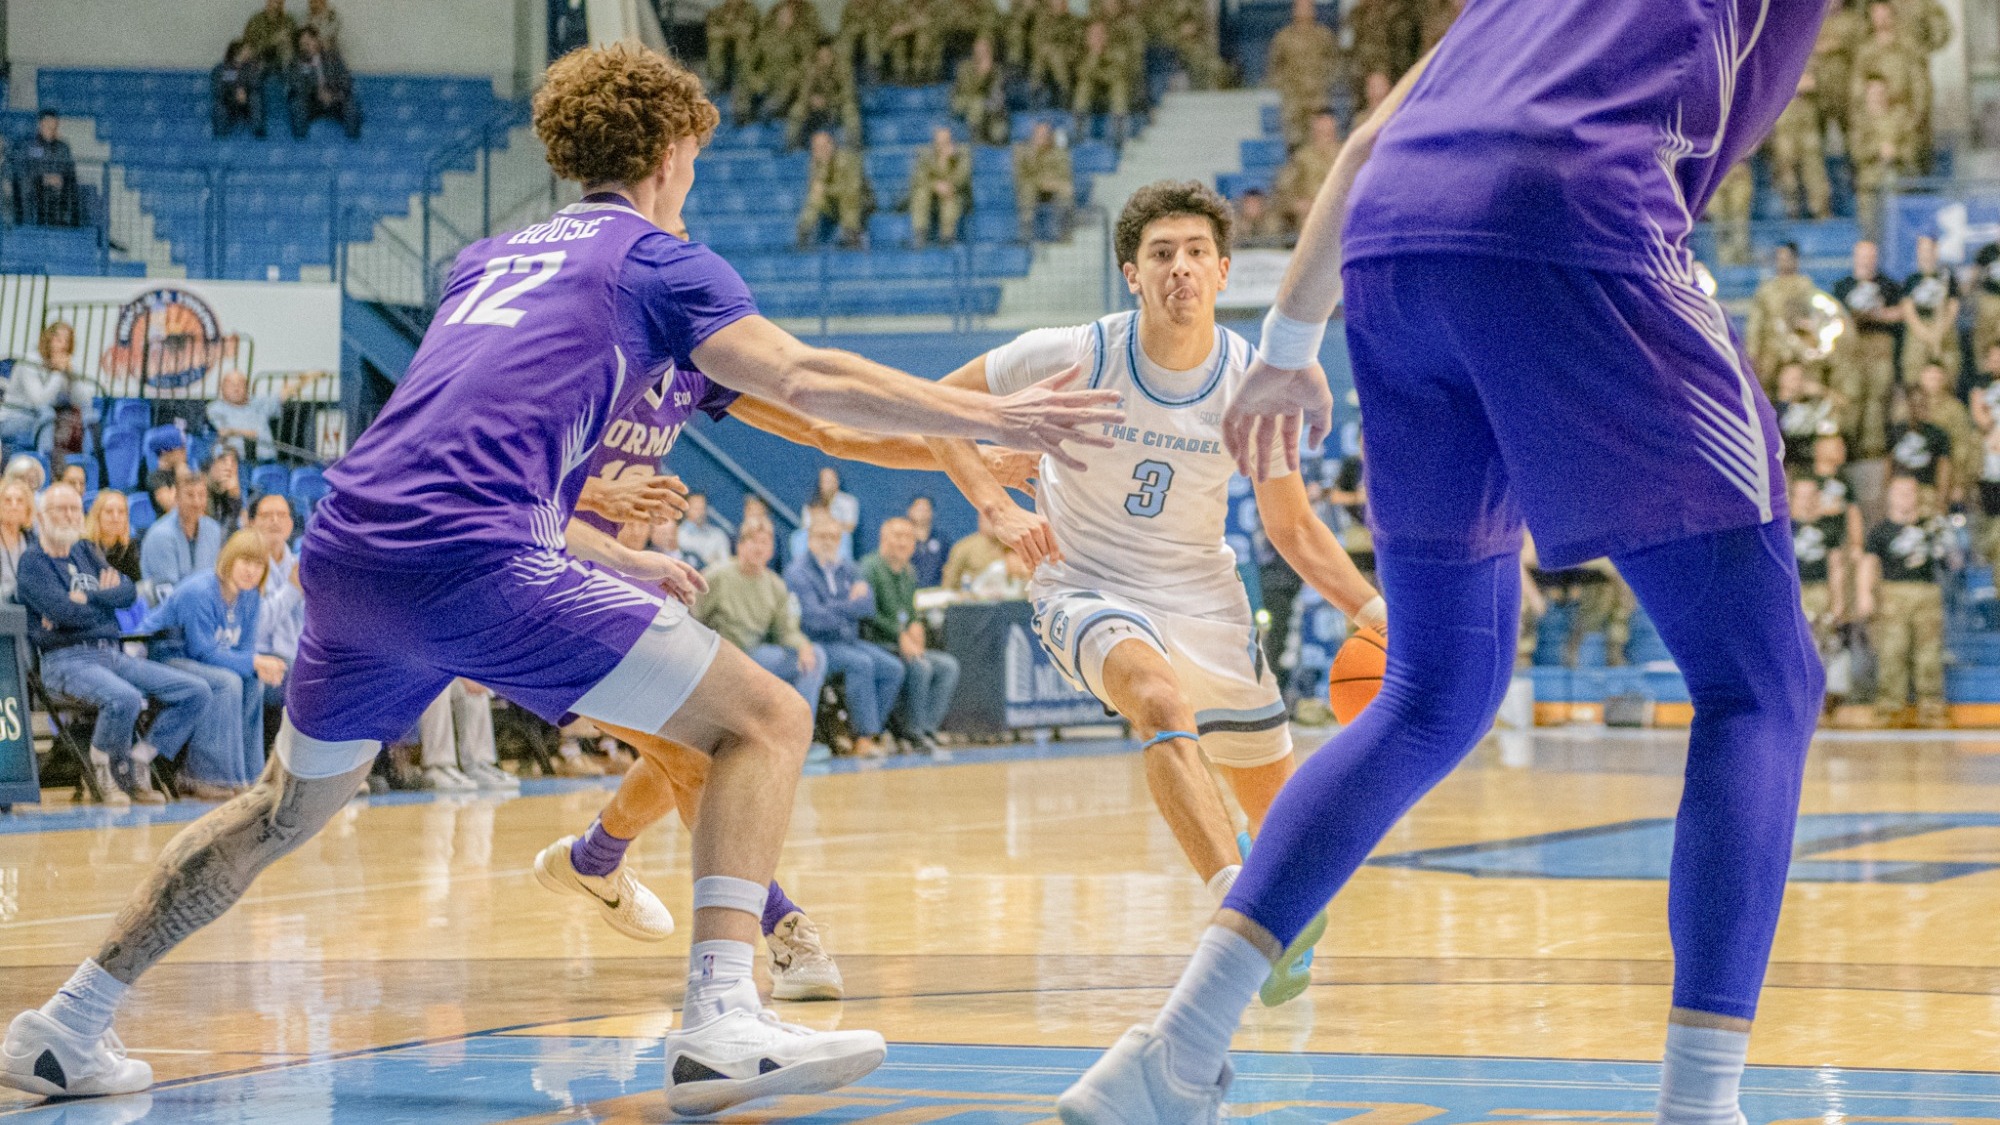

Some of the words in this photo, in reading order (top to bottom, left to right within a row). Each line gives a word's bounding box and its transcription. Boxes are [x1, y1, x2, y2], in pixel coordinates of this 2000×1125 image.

[506, 215, 616, 245] HOUSE
[443, 250, 568, 328] 12
[1102, 423, 1139, 442] THE
[1142, 430, 1222, 455] CITADEL
[1124, 458, 1175, 519] 3
